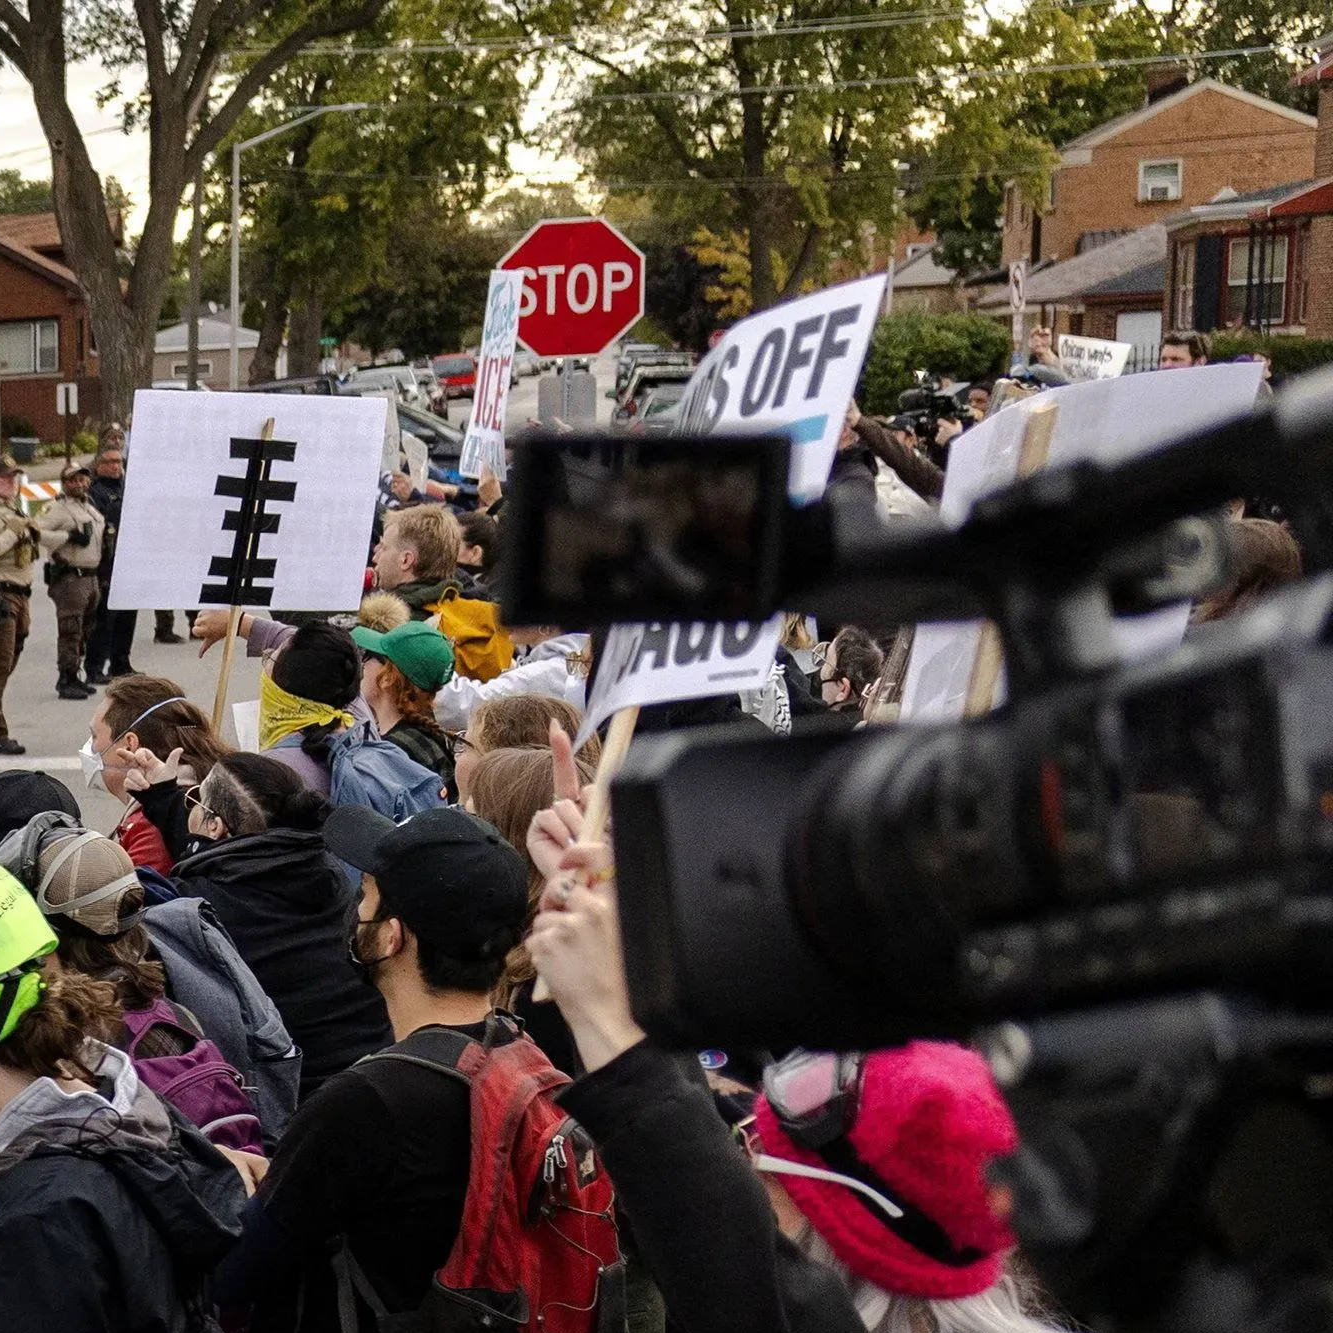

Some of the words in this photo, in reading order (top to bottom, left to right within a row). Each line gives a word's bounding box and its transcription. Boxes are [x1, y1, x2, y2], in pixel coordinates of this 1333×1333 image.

[519, 262, 633, 318] STOP
[474, 355, 511, 431] ICE
[740, 303, 862, 418] OFF
